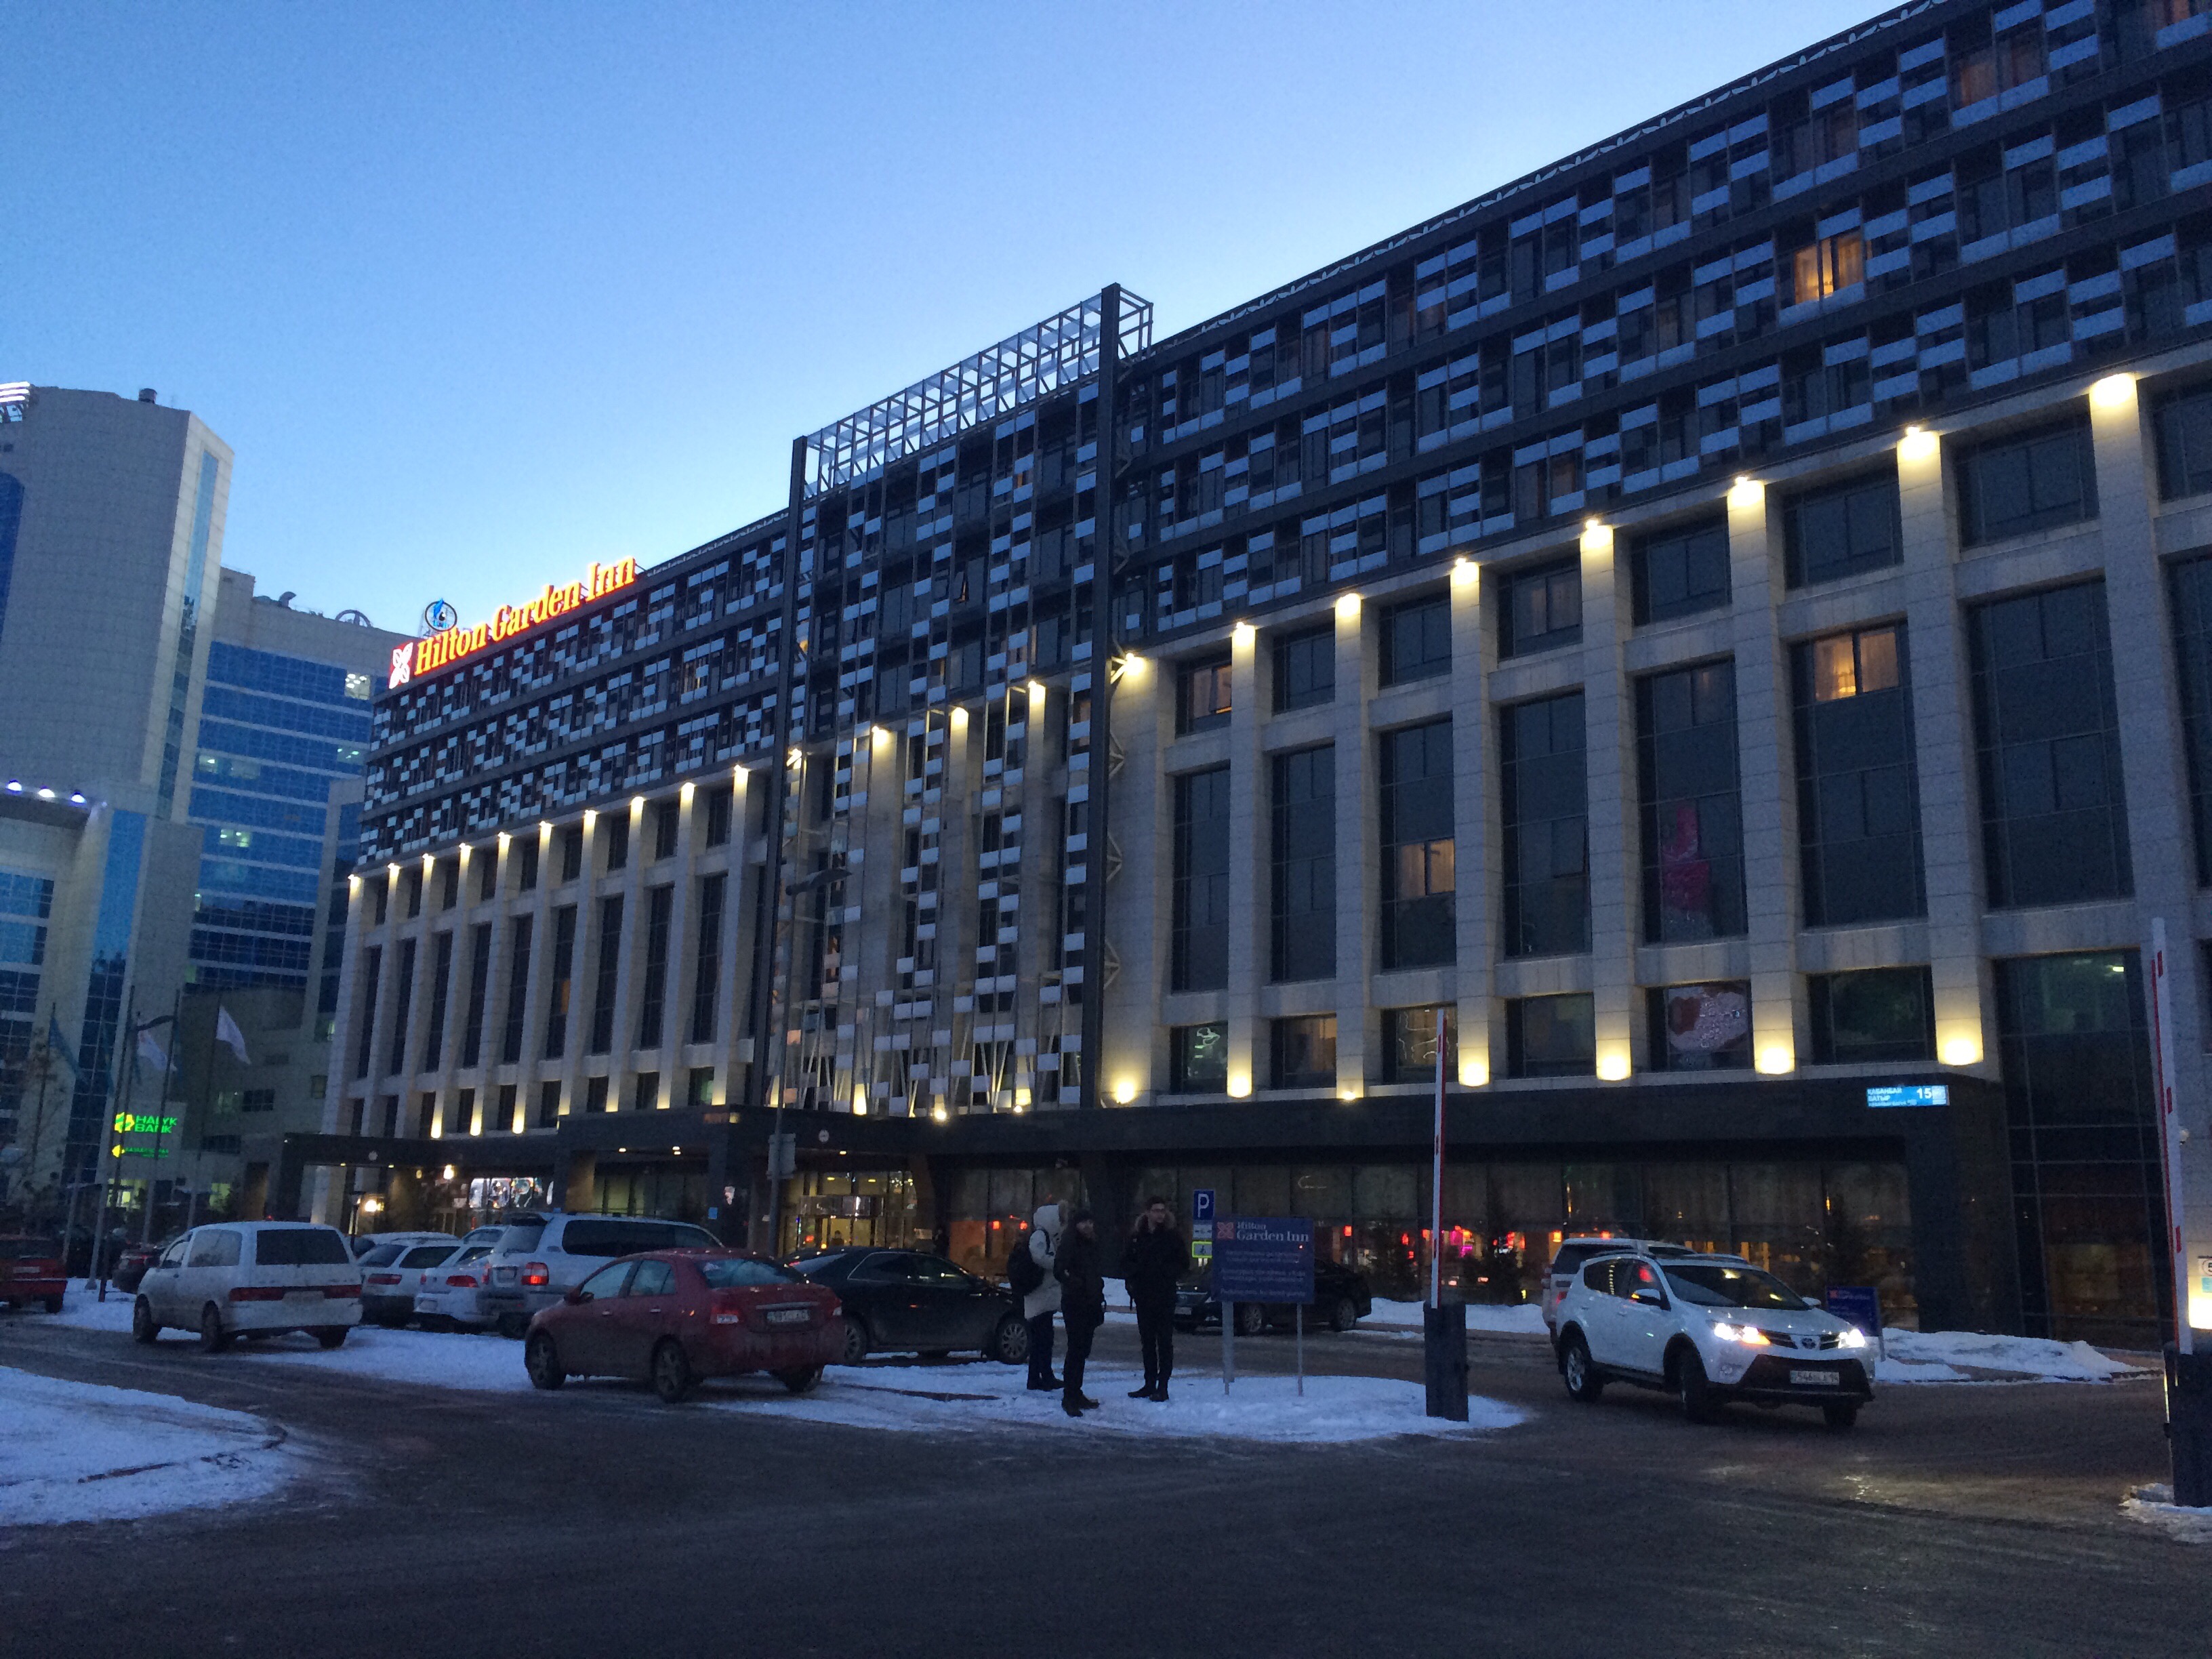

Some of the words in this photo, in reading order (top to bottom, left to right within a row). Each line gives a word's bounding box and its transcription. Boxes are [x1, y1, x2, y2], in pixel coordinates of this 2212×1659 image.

[415, 621, 488, 676] Hilton
[491, 581, 581, 641] Garden
[586, 556, 636, 601] Inn
[134, 1123, 173, 1134] BANK
[1197, 1193, 1210, 1218] P
[1237, 1221, 1267, 1230] Hilton
[1236, 1229, 1284, 1241] Garden
[1287, 1231, 1309, 1242] Inn
